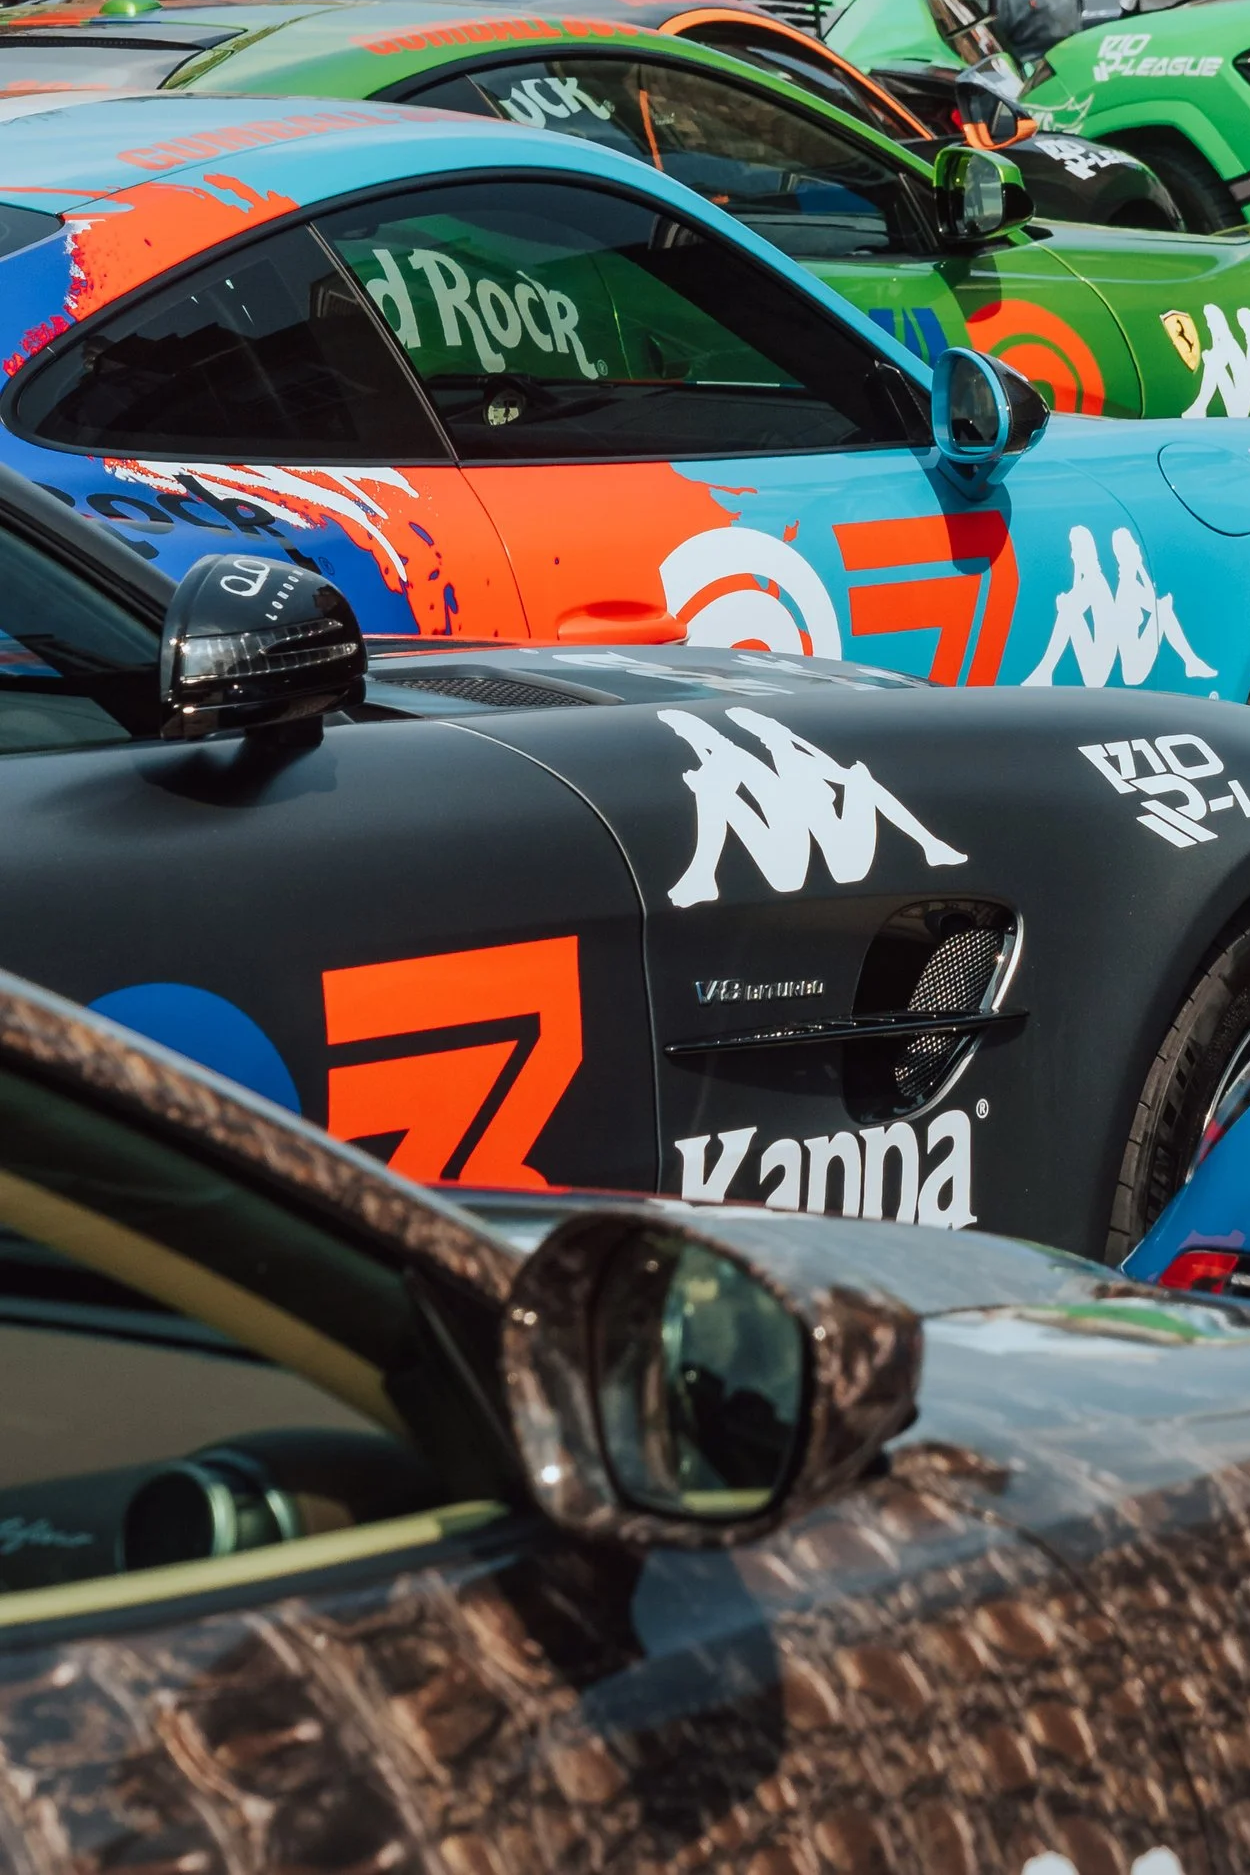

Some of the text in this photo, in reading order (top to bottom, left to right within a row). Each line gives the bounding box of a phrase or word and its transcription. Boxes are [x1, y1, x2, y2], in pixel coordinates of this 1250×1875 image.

[116, 109, 400, 171] GUMBALL
[694, 978, 824, 1005] V8 BITURBO
